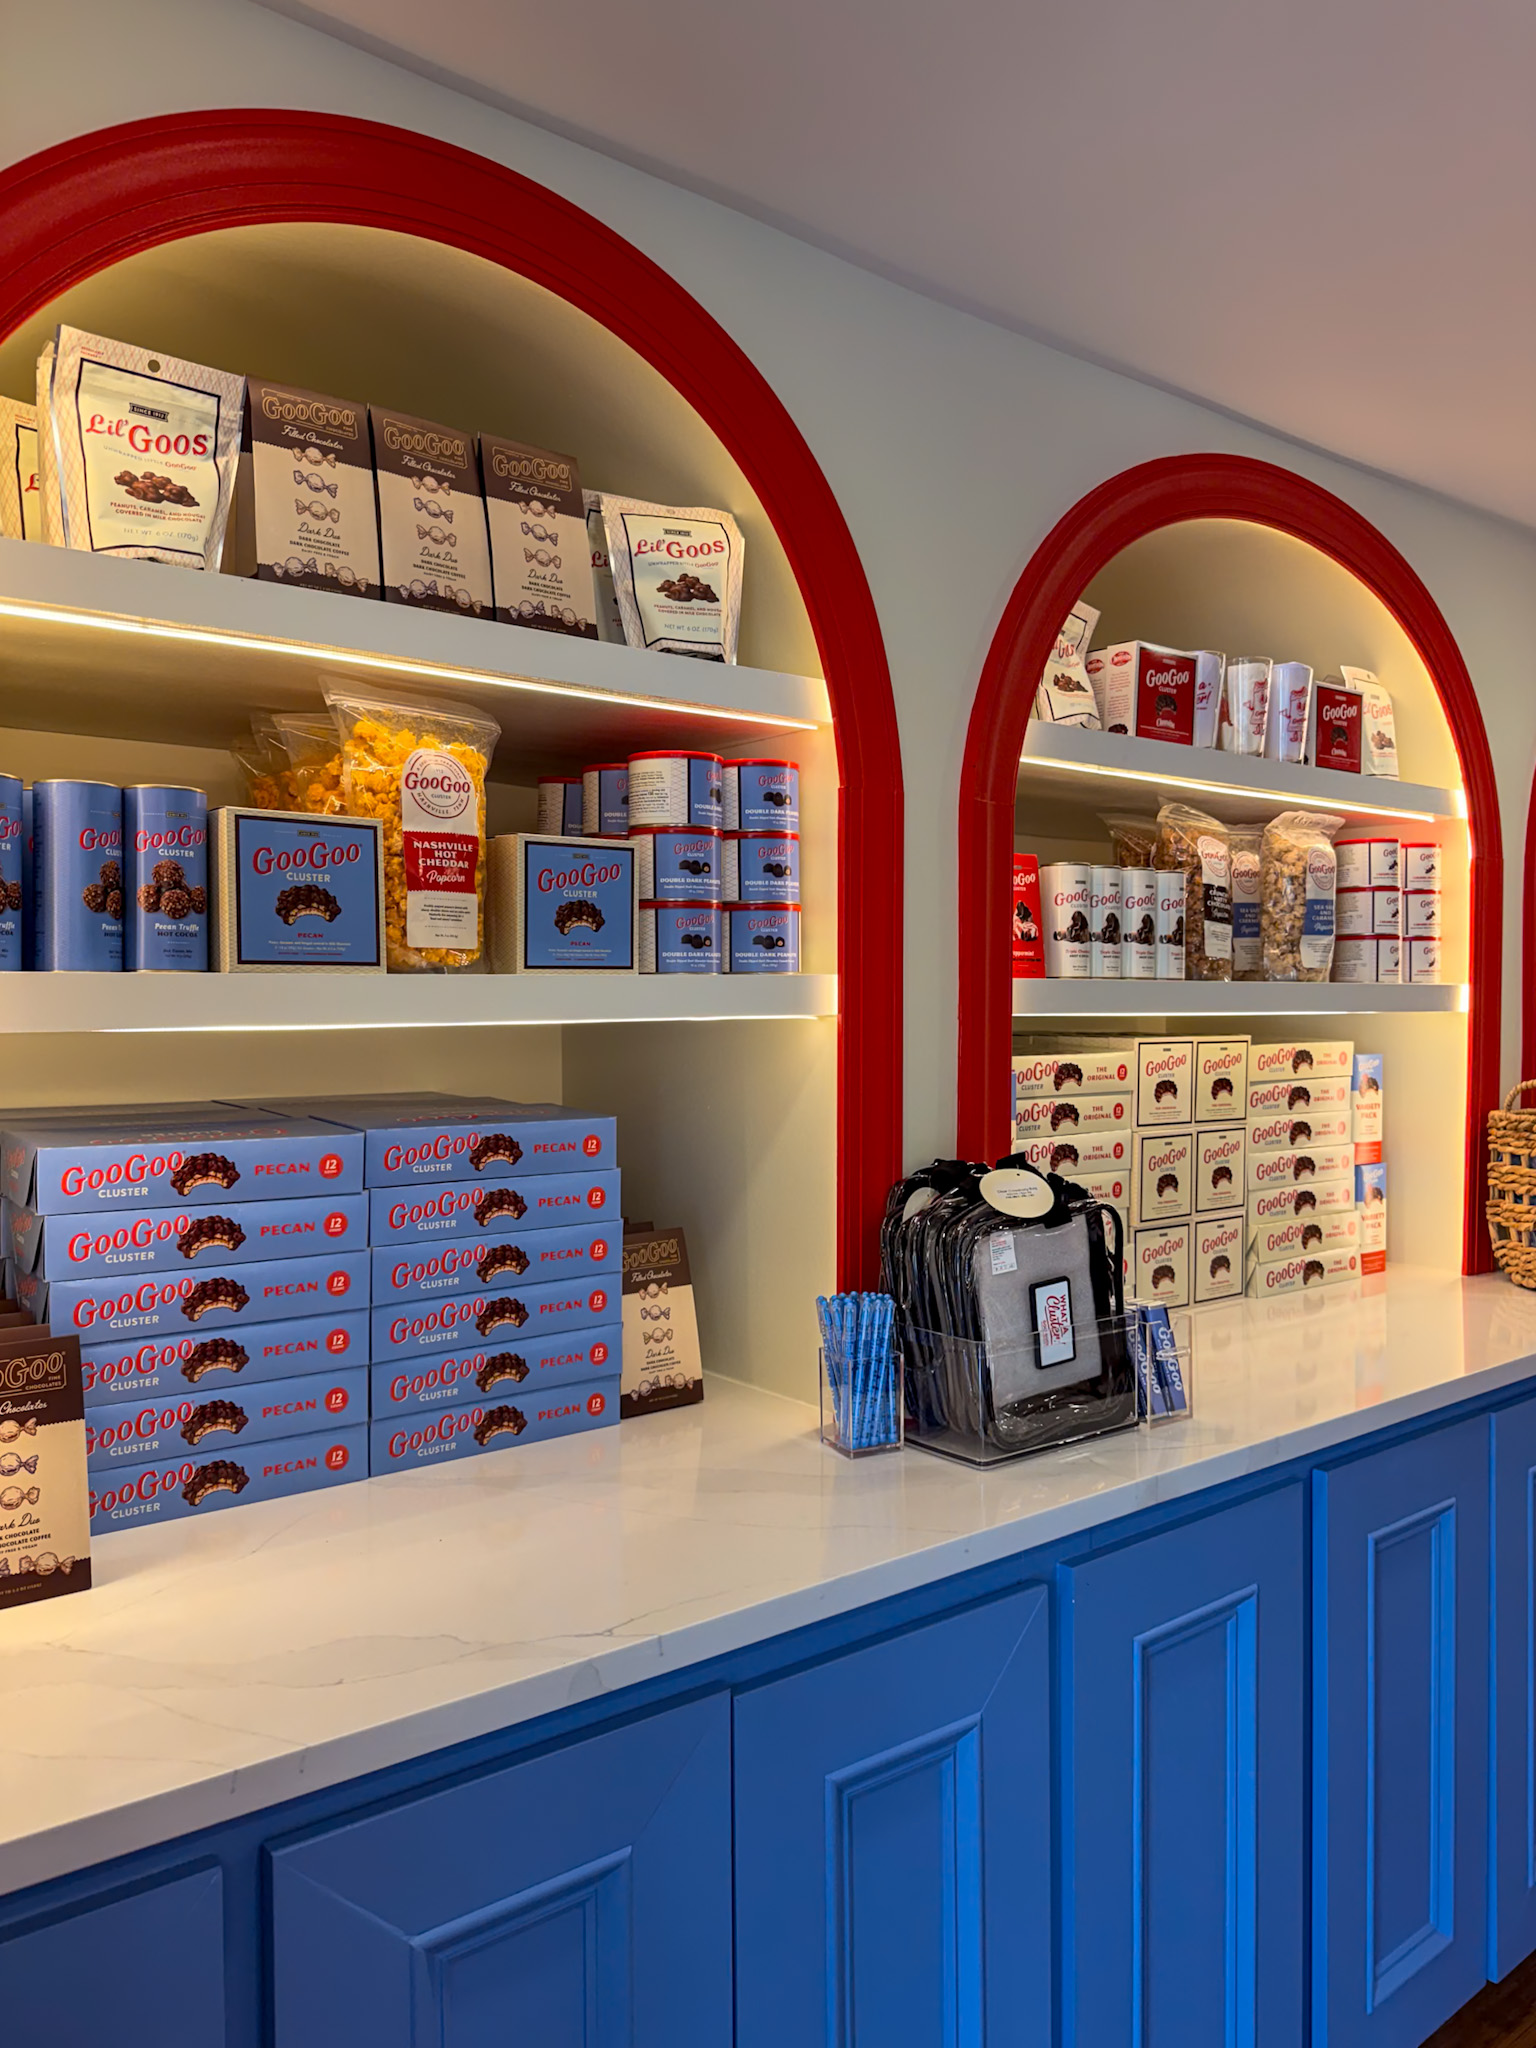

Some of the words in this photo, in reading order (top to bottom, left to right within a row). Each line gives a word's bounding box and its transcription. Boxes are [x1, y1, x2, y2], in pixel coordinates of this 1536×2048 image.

[262, 396, 355, 426] GooGoo
[281, 424, 306, 440] Filled
[306, 432, 344, 450] Chocolates
[384, 426, 464, 456] GooGoo
[492, 454, 569, 480] GooGoo
[115, 508, 144, 517] COVERED
[168, 516, 202, 524] CHOCOLATE
[297, 522, 322, 536] Dark
[289, 540, 304, 548] DARK
[304, 542, 332, 552] CHOCOLATE
[312, 538, 340, 548] CHOCOLATE
[592, 550, 609, 568] Li
[1146, 668, 1190, 688] GooGoo
[1322, 703, 1358, 722] GooGoo
[404, 772, 470, 794] GooGoo
[79, 828, 122, 851] Goo
[413, 840, 474, 853] NASHVILLE
[158, 848, 195, 858] CLUSTER
[252, 842, 361, 876] GooGoo
[434, 850, 458, 859] HOT
[418, 858, 469, 869] CHEDDAR
[286, 872, 332, 883] CLUSTER
[426, 870, 466, 886] Popcorn
[538, 863, 622, 893] GooGoo
[563, 890, 598, 898] CLUSTER
[1054, 888, 1090, 907] GooG
[154, 922, 177, 930] Pecan
[1146, 1054, 1187, 1077] GooGoo
[1203, 1052, 1242, 1075] GooGoo
[1257, 1047, 1296, 1072] GooGoo
[1017, 1060, 1059, 1085] ooGoo
[1086, 1074, 1116, 1082] ORIGINAL
[1021, 1083, 1044, 1091] CLUSTER
[1250, 1084, 1293, 1108] GooGoo
[1016, 1101, 1056, 1126] ooGoo
[1084, 1113, 1112, 1121] ORIGINAL
[1018, 1124, 1041, 1132] CLUSTER
[1252, 1119, 1294, 1144] GooGoo
[383, 1132, 481, 1172] GooGoo
[533, 1142, 576, 1154] PECAN
[1204, 1140, 1240, 1164] GooGoo
[325, 1159, 338, 1170] 12
[1083, 1153, 1112, 1161] ORIGINAL
[1148, 1146, 1187, 1172] GooGoo
[61, 1150, 185, 1196] GooGoo
[254, 1162, 311, 1177] PECAN
[412, 1163, 452, 1174] CLUSTER
[1256, 1154, 1298, 1180] GooGoo
[98, 1186, 149, 1199] CLUSTER
[538, 1194, 581, 1208] PECAN
[1094, 1192, 1111, 1200] GINAL
[388, 1186, 485, 1230] GooGoo
[1257, 1190, 1298, 1216] GooGoo
[260, 1221, 316, 1238] PECAN
[329, 1217, 342, 1229] 12
[417, 1220, 457, 1232] CLUSTER
[68, 1214, 191, 1264] GooGoo
[1202, 1228, 1238, 1254] GooGoo
[1267, 1224, 1305, 1251] GooGoo
[105, 1250, 156, 1265] CLUSTER
[540, 1248, 584, 1262] PECAN
[1142, 1237, 1184, 1264] GooGoo
[391, 1244, 488, 1290] GooGoo
[1266, 1259, 1306, 1288] GooGoo
[263, 1281, 319, 1298] PECAN
[332, 1276, 346, 1288] 12
[420, 1277, 460, 1290] CLUSTER
[73, 1277, 195, 1329] GooGoo
[539, 1299, 582, 1314] PECAN
[1060, 1294, 1068, 1323] WHAT
[110, 1314, 160, 1329] CLUSTER
[389, 1297, 487, 1345] GooGoo
[1046, 1295, 1066, 1345] Cluster!
[419, 1331, 459, 1345] CLUSTER
[1062, 1326, 1068, 1335] A
[332, 1334, 344, 1346] 12
[263, 1340, 318, 1358] PECAN
[540, 1352, 584, 1369] PECAN
[110, 1377, 160, 1392] CLUSTER
[389, 1353, 487, 1402] GooGoo
[25, 1381, 62, 1392] CHOCOLATES
[419, 1388, 459, 1402] CLUSTER
[330, 1393, 344, 1405] 12
[262, 1399, 317, 1418] PECAN
[538, 1404, 581, 1422] PECAN
[388, 1407, 485, 1459] GooGoo
[110, 1440, 160, 1457] CLUSTER
[417, 1442, 457, 1458] CLUSTER
[263, 1457, 318, 1478] PECAN
[111, 1502, 161, 1520] CLUSTER
[0, 1518, 16, 1531] ark
[18, 1512, 41, 1528] Duo
[5, 1528, 40, 1540] CHOCOLATE
[30, 1533, 51, 1543] COFFEE
